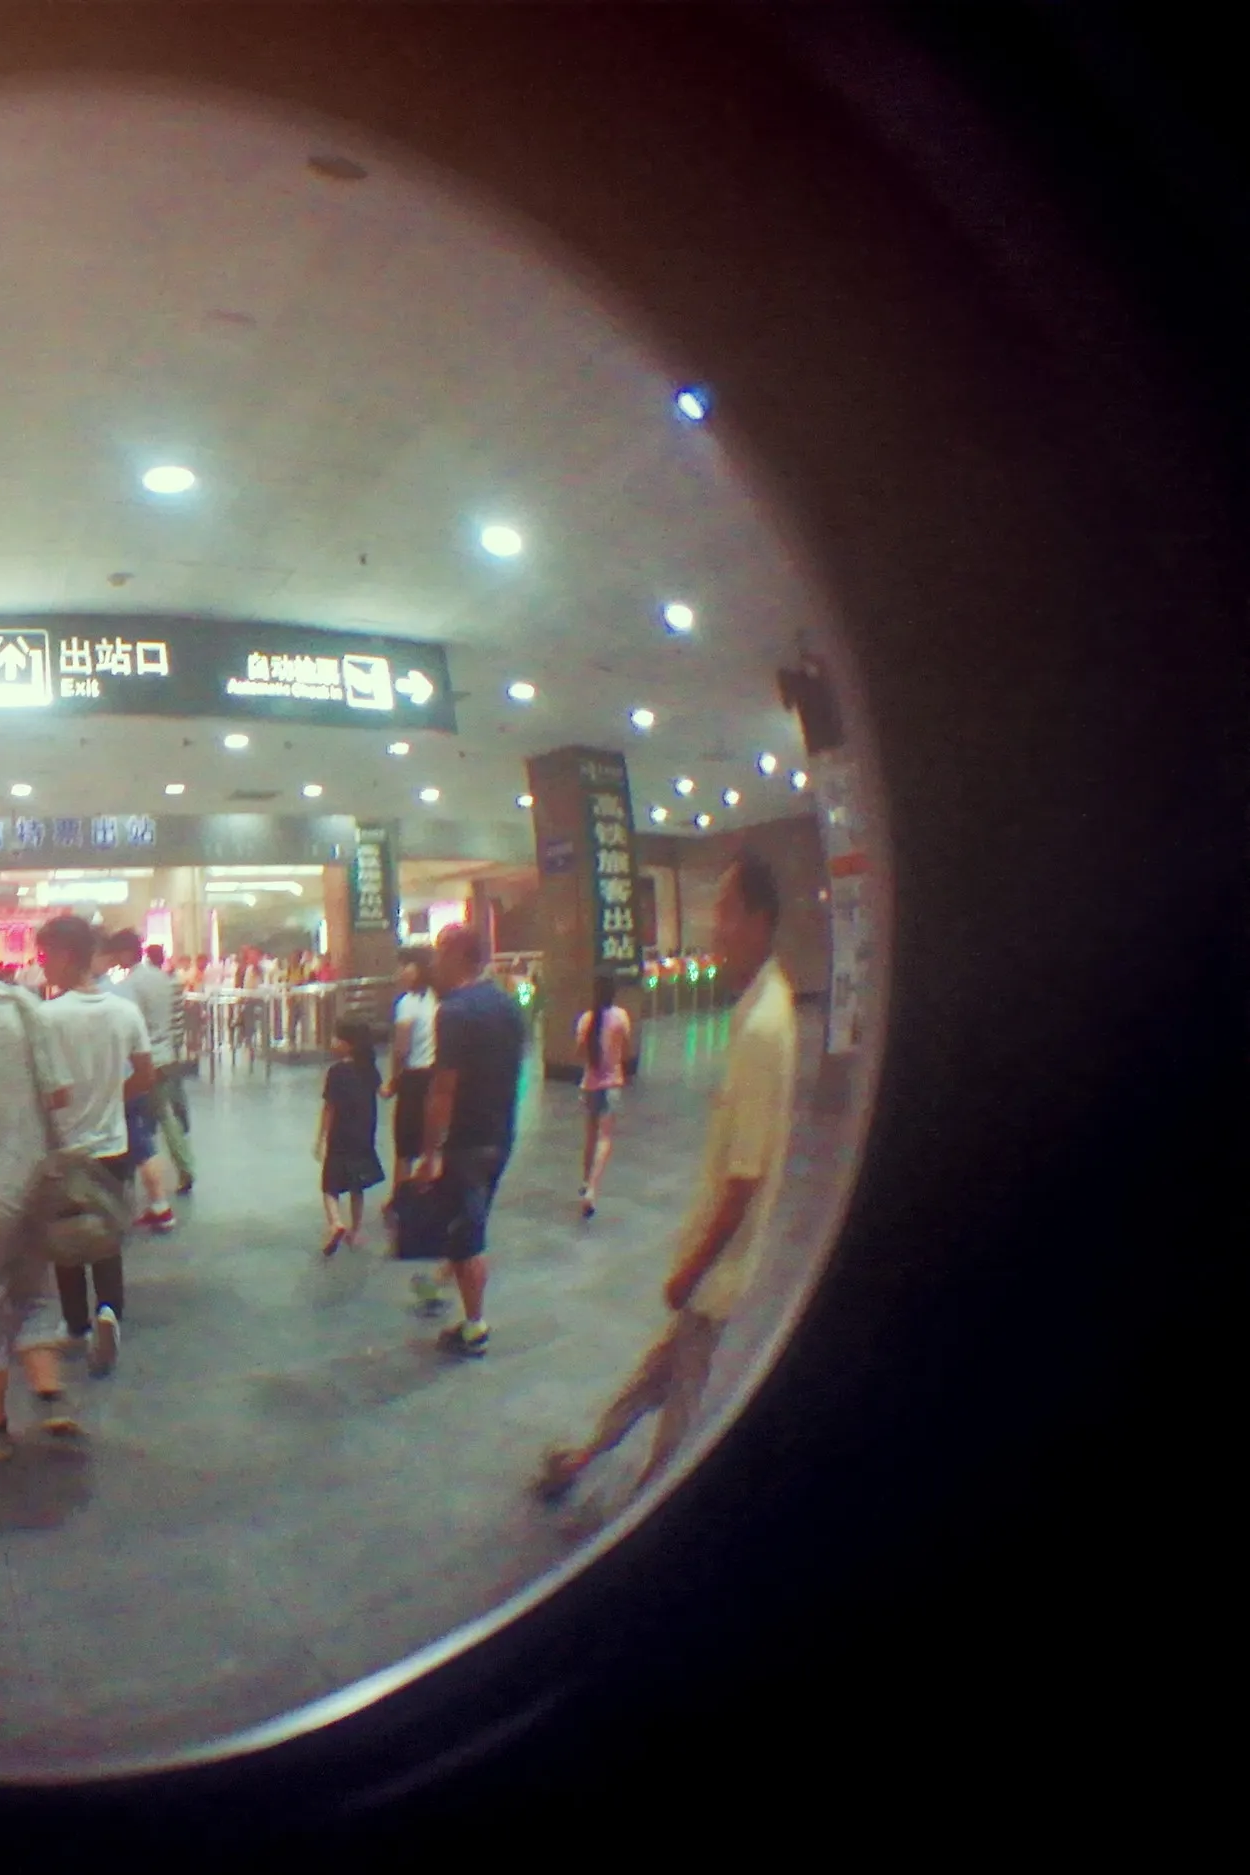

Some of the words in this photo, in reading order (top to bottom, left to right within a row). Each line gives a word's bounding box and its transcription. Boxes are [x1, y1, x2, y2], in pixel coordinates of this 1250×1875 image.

[60, 637, 168, 675] 出站口
[60, 678, 100, 698] Exit
